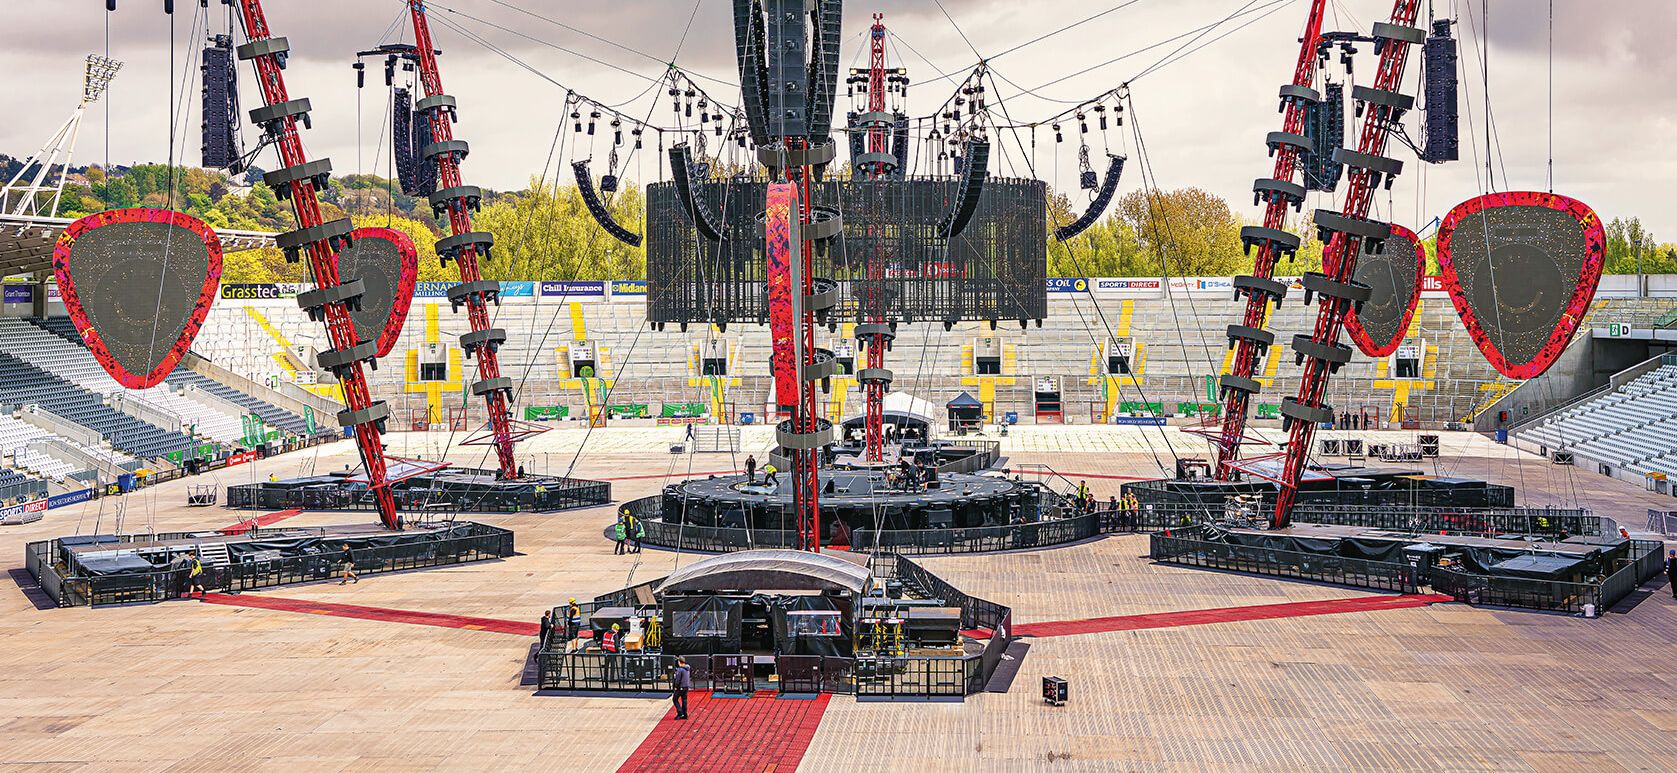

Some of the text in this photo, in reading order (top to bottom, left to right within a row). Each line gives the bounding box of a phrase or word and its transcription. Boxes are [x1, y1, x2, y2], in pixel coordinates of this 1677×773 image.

[221, 284, 277, 298] Grasstec
[542, 284, 603, 292] Chill Insurance
[1622, 325, 1629, 335] D
[0, 501, 46, 519] SPORTS DIRECT
